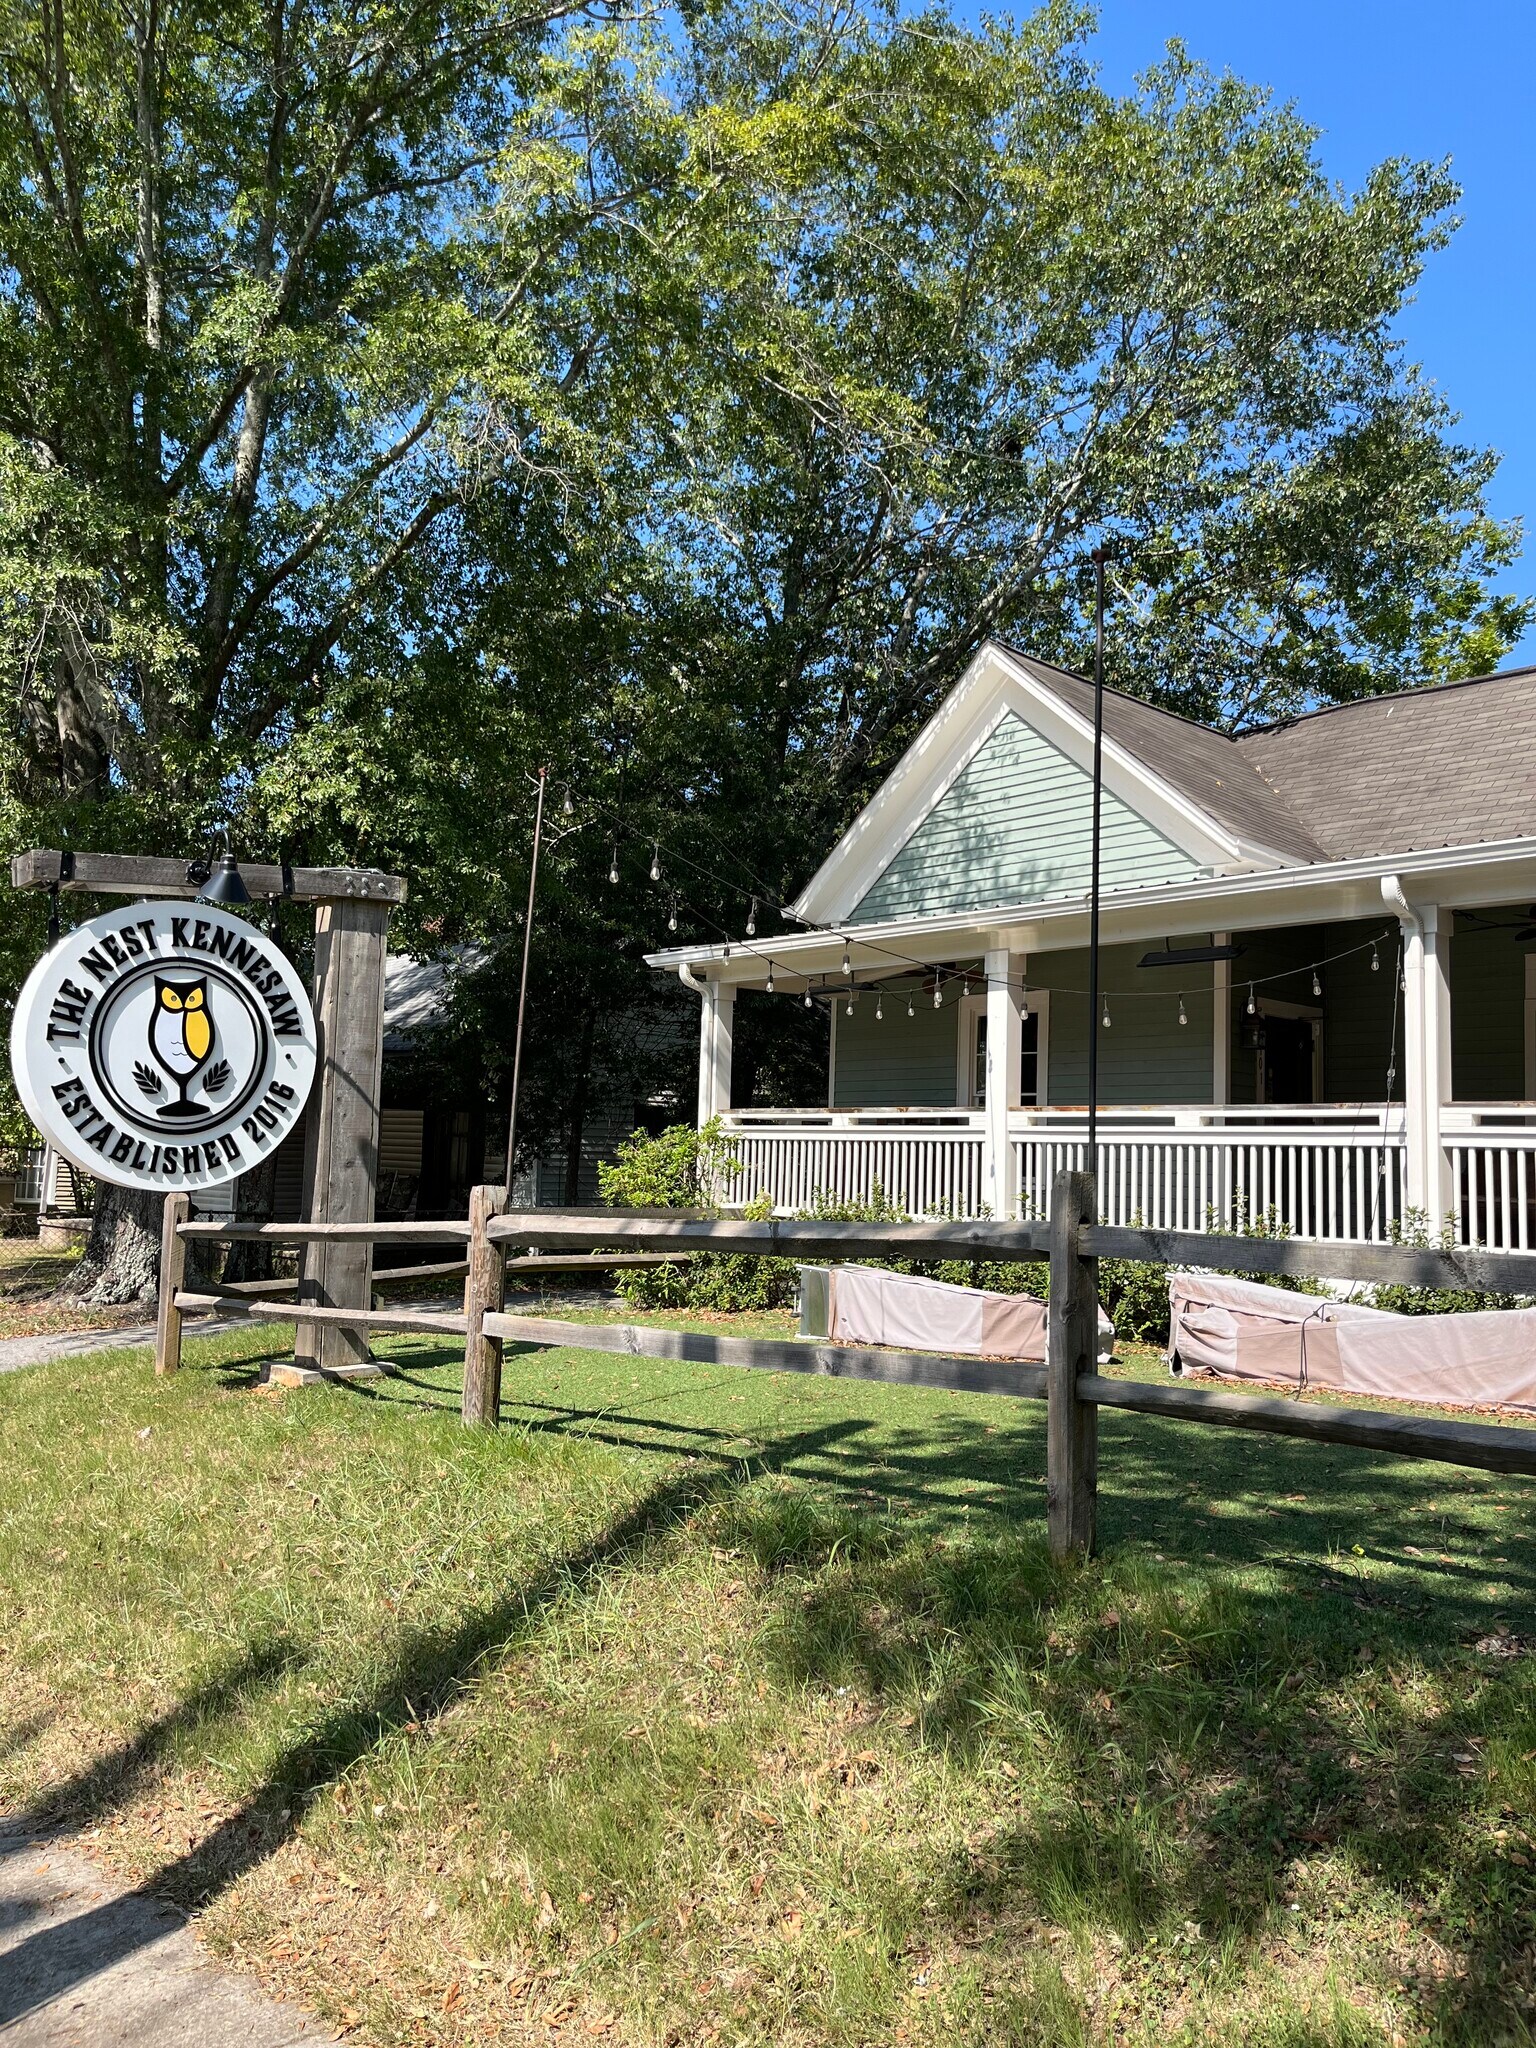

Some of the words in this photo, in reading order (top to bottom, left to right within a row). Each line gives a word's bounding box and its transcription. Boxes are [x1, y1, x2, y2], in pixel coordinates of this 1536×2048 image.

[46, 978, 94, 1042] THE
[78, 919, 158, 982] NEST
[170, 917, 303, 1037] KENNESAW
[50, 1076, 241, 1175] ESTABLISHED
[243, 1080, 296, 1143] 2016
